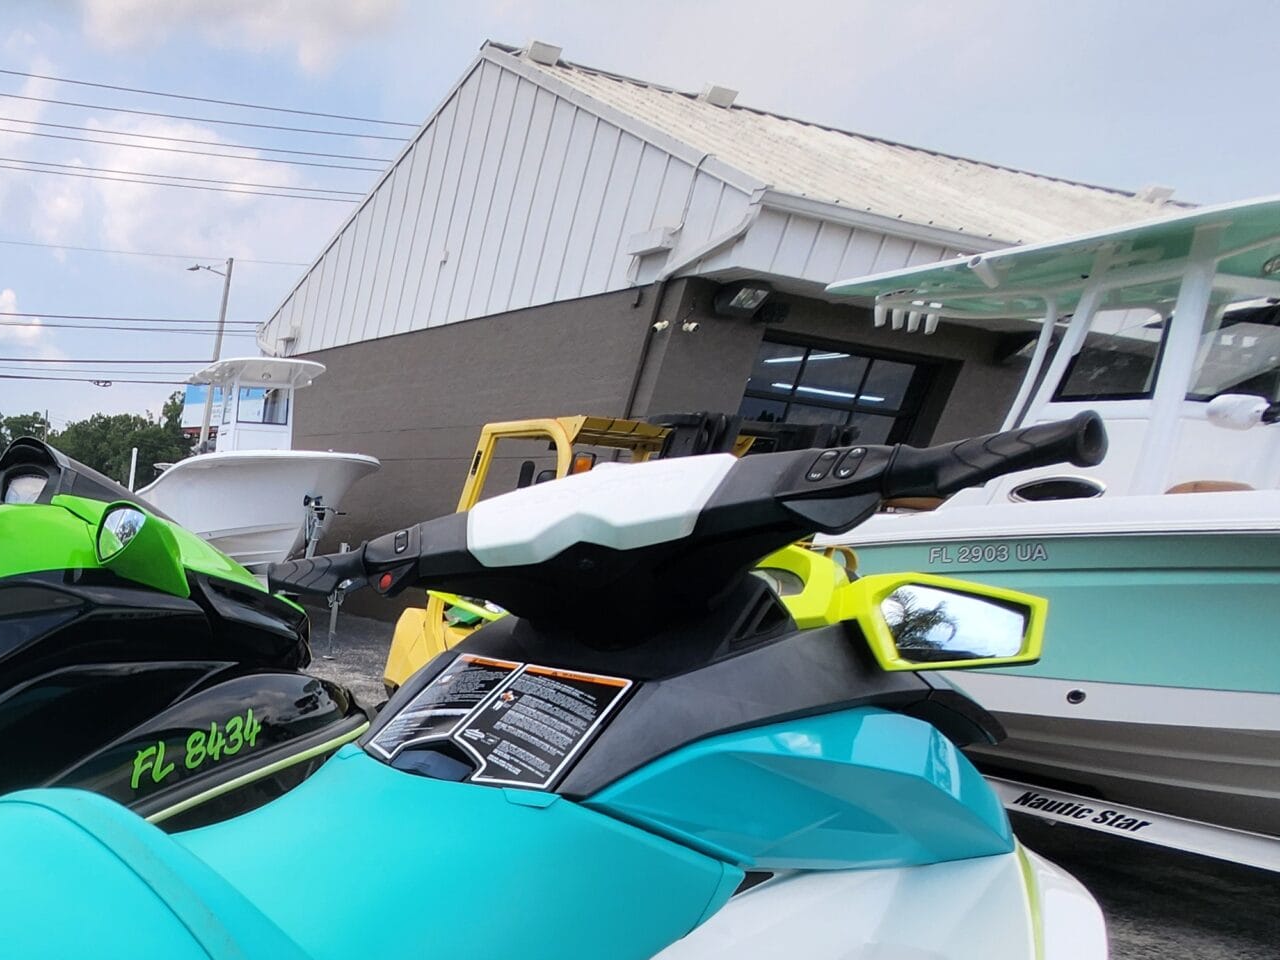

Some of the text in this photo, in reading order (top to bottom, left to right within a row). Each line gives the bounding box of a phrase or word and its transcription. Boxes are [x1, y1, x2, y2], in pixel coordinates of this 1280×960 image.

[929, 543, 1048, 563] FL 2903 UA
[131, 708, 261, 789] FL 8434
[1013, 791, 1152, 832] Nautic Star
